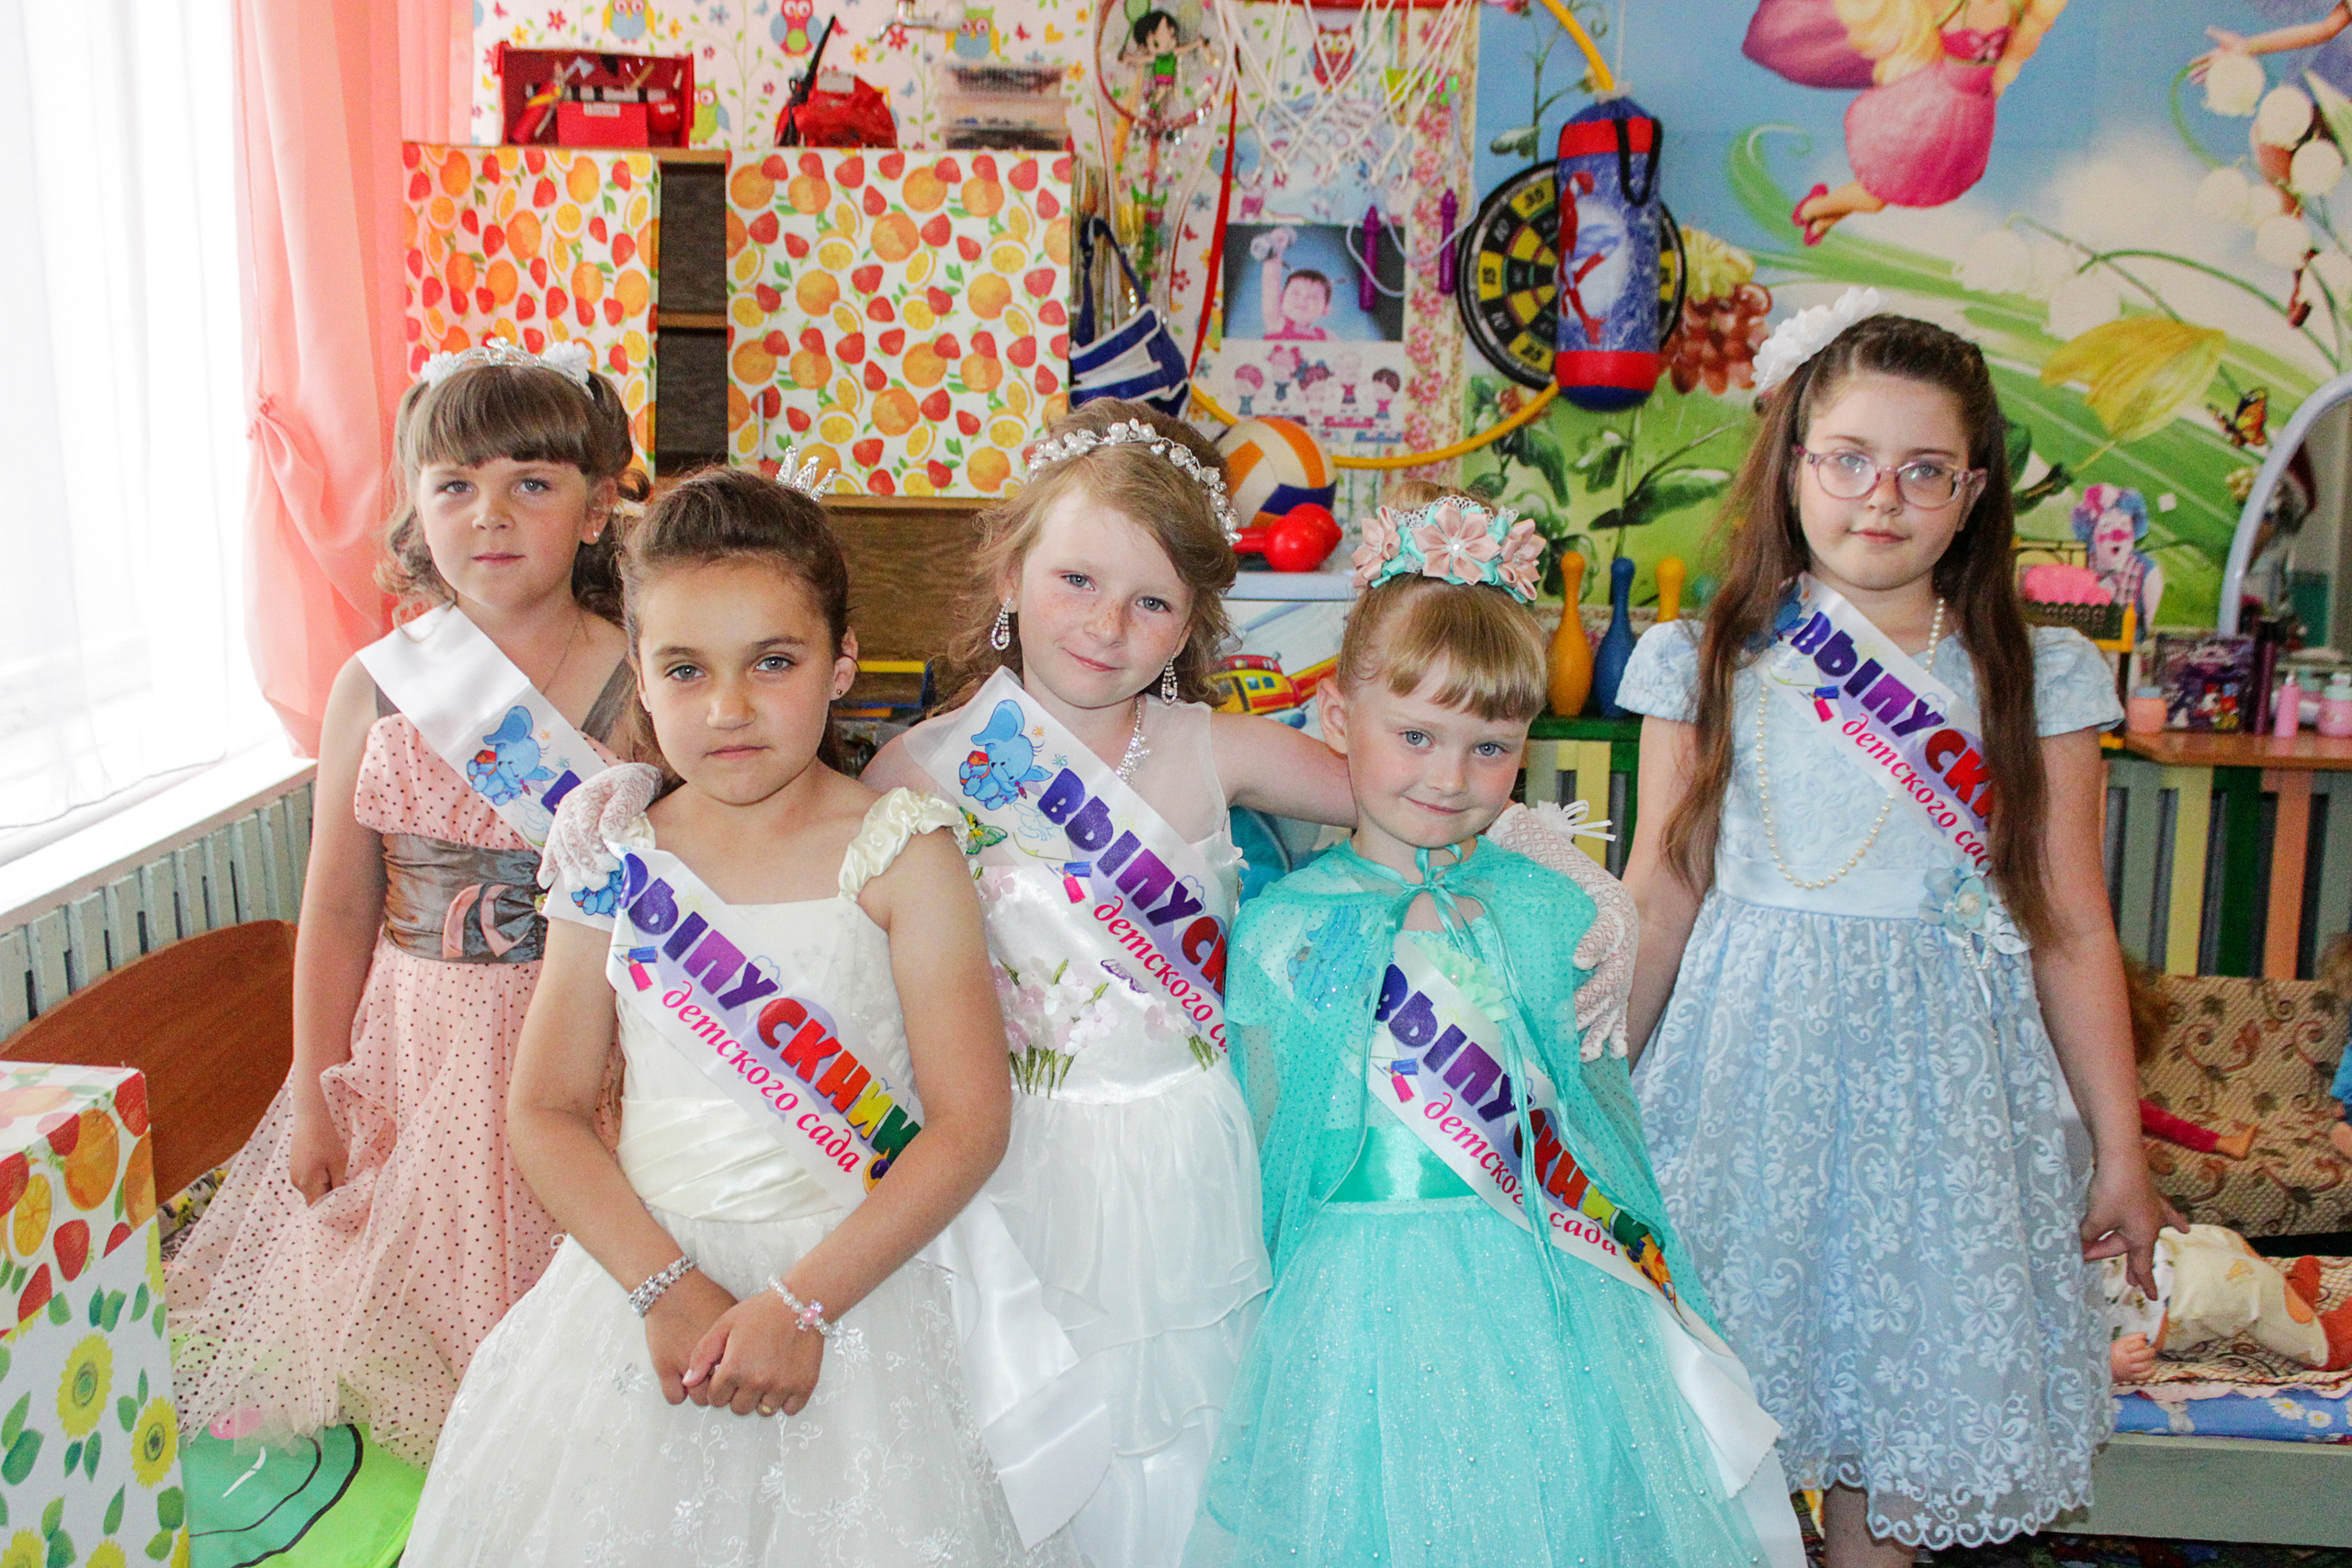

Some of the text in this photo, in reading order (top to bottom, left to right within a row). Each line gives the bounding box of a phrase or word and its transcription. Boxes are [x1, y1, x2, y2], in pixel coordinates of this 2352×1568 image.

[1842, 713, 1958, 828] детского
[1093, 896, 1214, 1021] детского
[662, 980, 861, 1173] детского сада
[1549, 1213, 1619, 1257] сада
